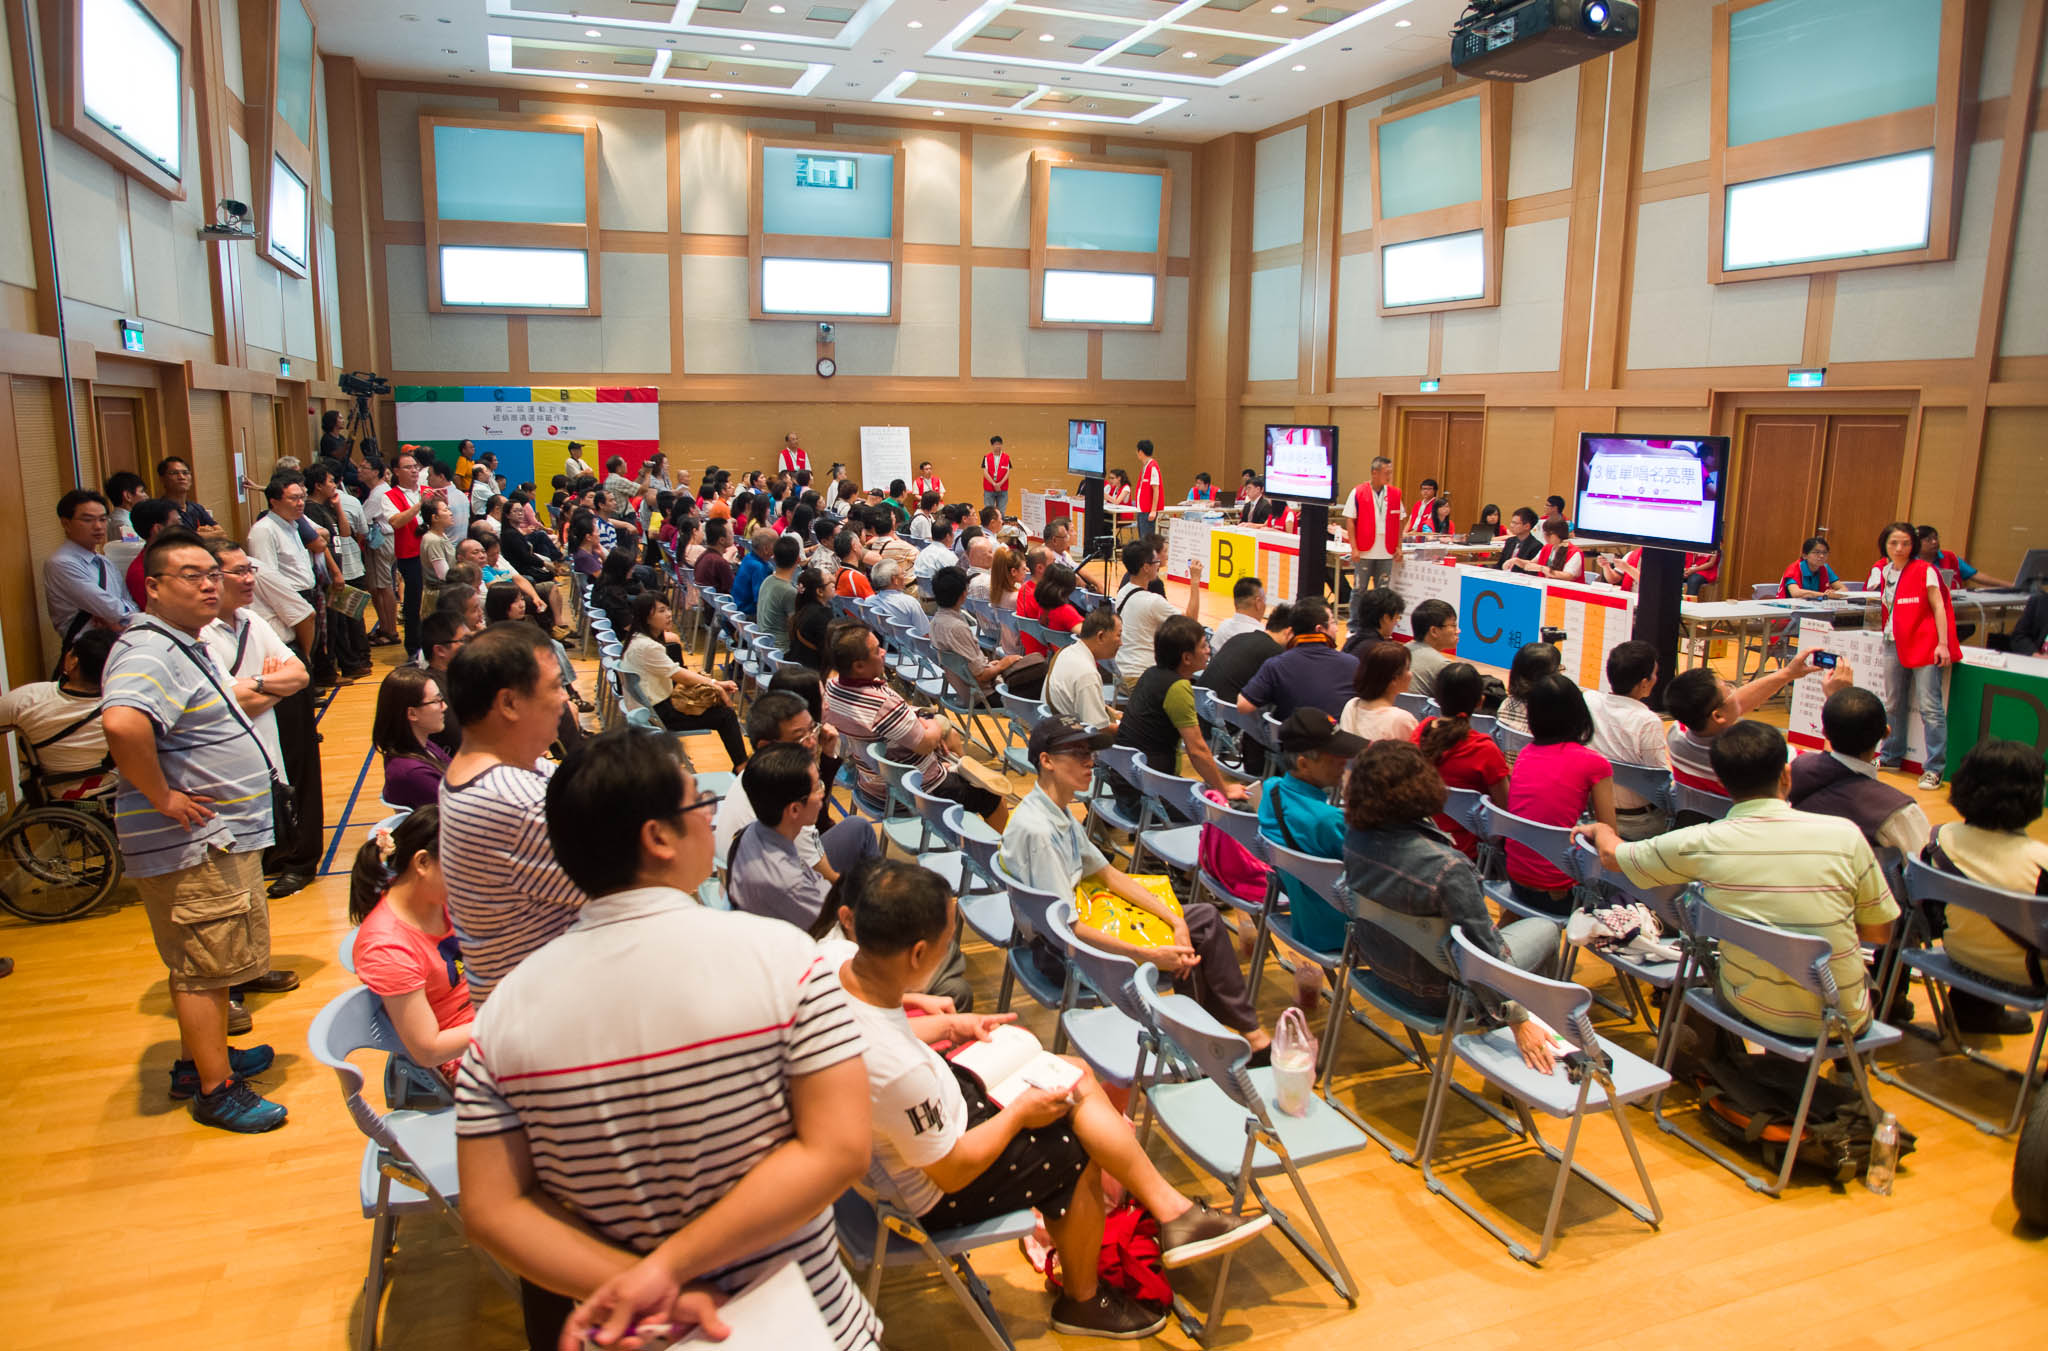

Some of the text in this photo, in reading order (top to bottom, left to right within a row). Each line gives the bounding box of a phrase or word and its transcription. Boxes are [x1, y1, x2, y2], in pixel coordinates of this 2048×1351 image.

[493, 389, 505, 402] C
[560, 389, 570, 401] B
[623, 390, 634, 402] A
[1217, 539, 1234, 578] B
[1472, 590, 1504, 644] C
[1507, 629, 1523, 649] 組
